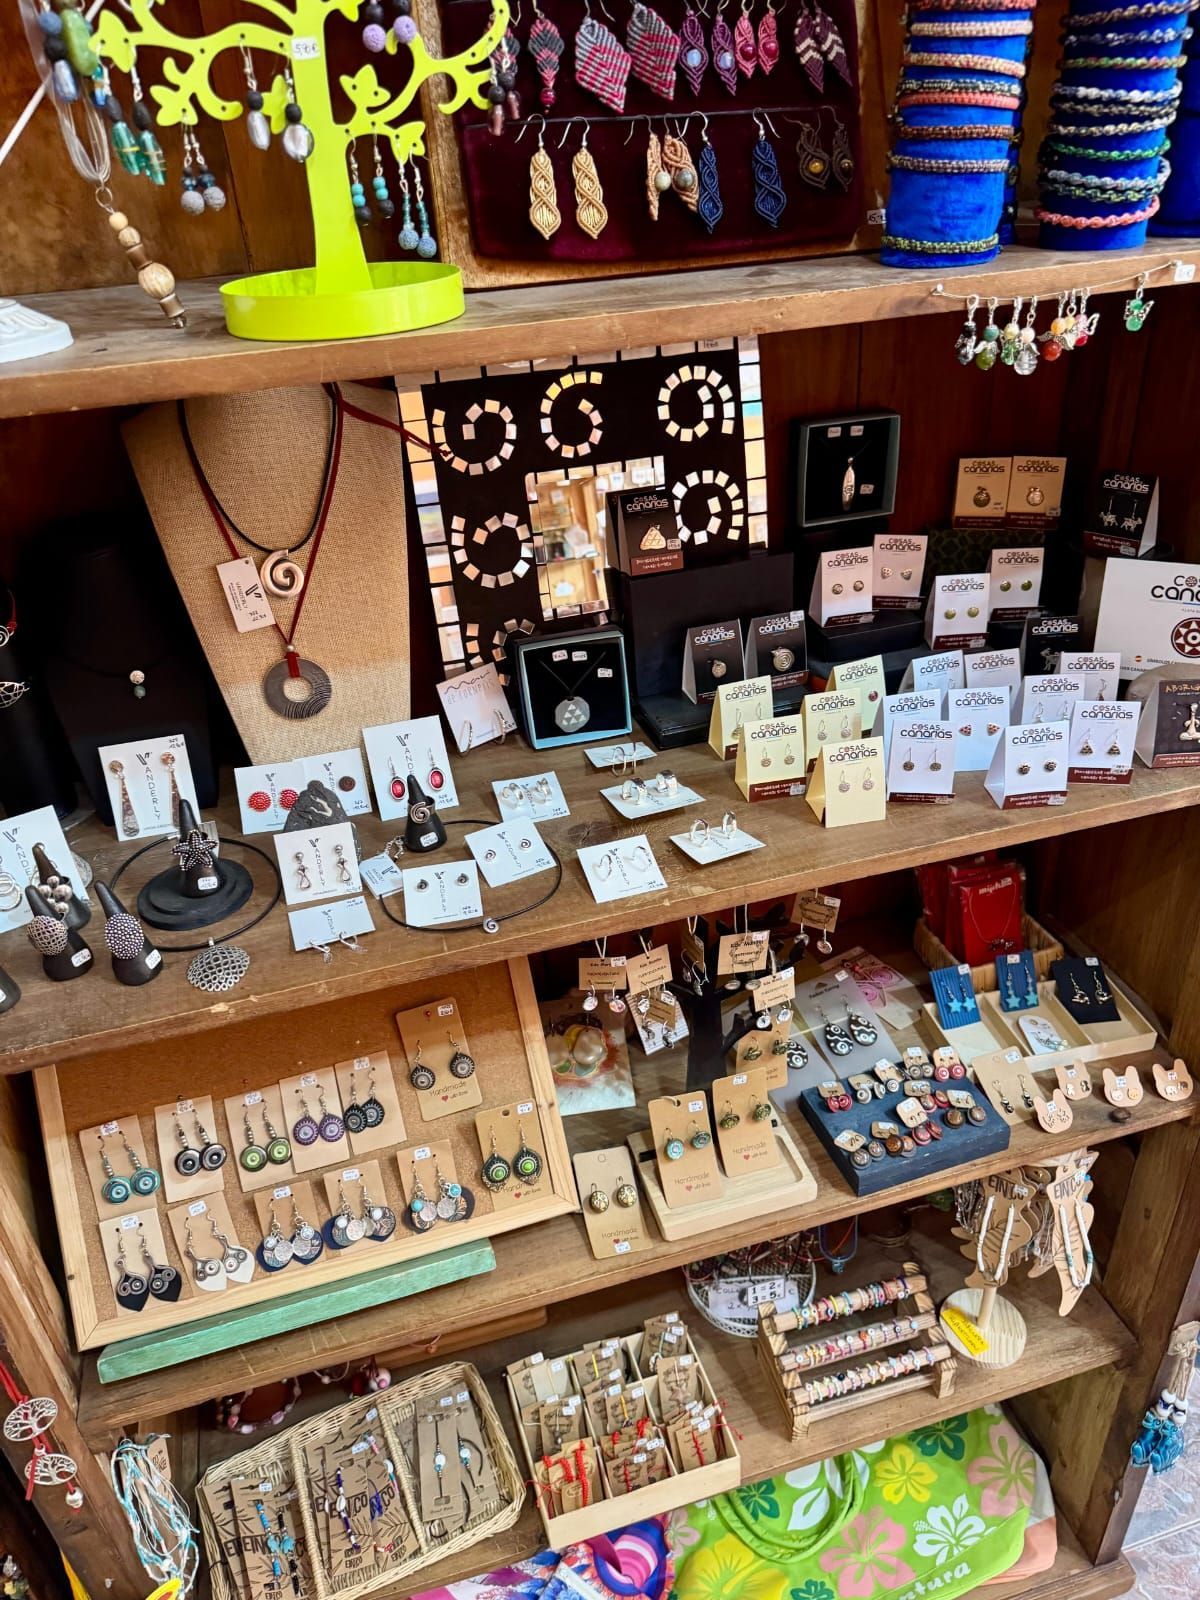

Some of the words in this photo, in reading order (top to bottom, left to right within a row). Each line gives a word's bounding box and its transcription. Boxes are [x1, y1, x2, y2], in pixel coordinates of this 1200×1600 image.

[1174, 575, 1200, 588] CO
[980, 654, 1004, 662] COSAS
[820, 695, 844, 703] COSAS
[899, 695, 924, 704] COSAS
[760, 722, 785, 730] COSAS
[1022, 727, 1051, 736] COSAS
[839, 744, 865, 753] COSAS
